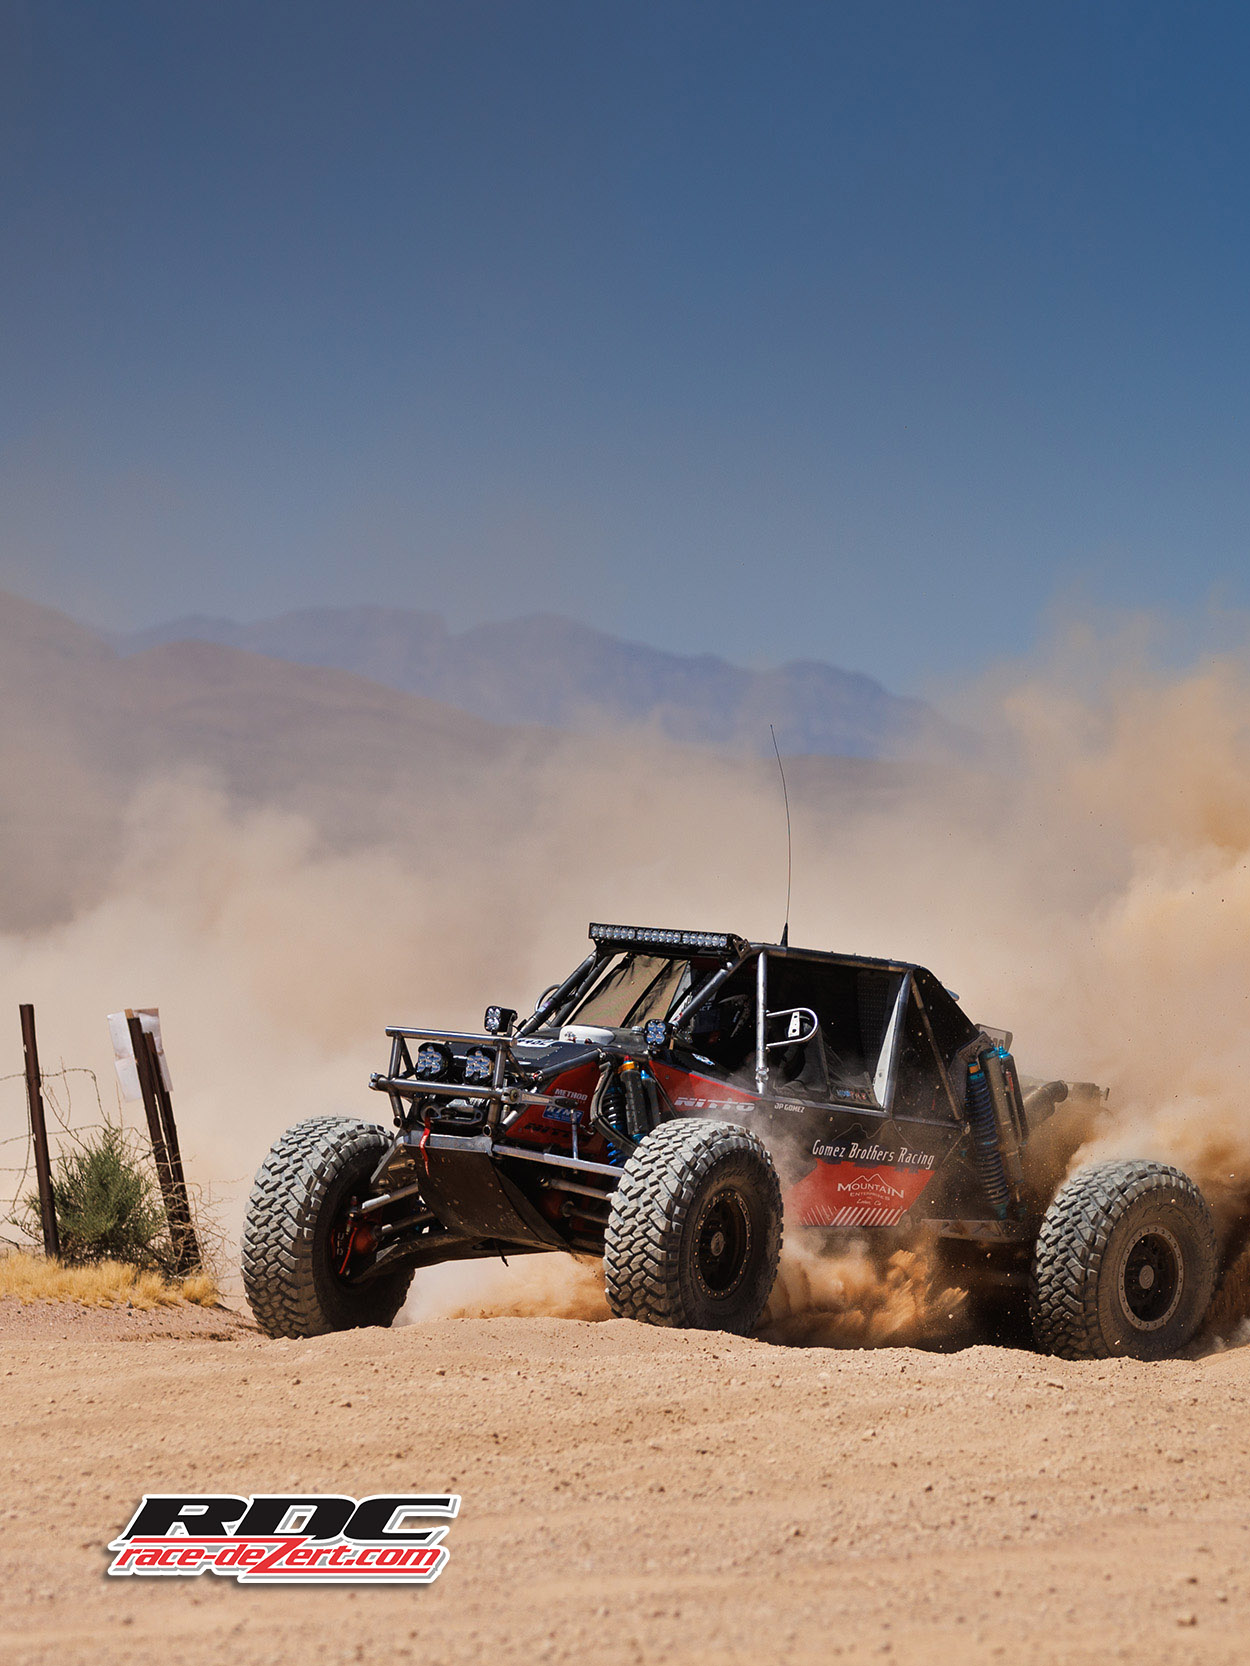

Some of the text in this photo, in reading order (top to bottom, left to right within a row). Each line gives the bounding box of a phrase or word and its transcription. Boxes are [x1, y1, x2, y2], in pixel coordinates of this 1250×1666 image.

[554, 1088, 588, 1101] METHOD
[674, 1096, 756, 1112] NITTO
[784, 1104, 806, 1114] GOMEZ
[812, 1139, 935, 1170] Gomez Brothers Racing
[837, 1182, 904, 1199] MOUNTAIN
